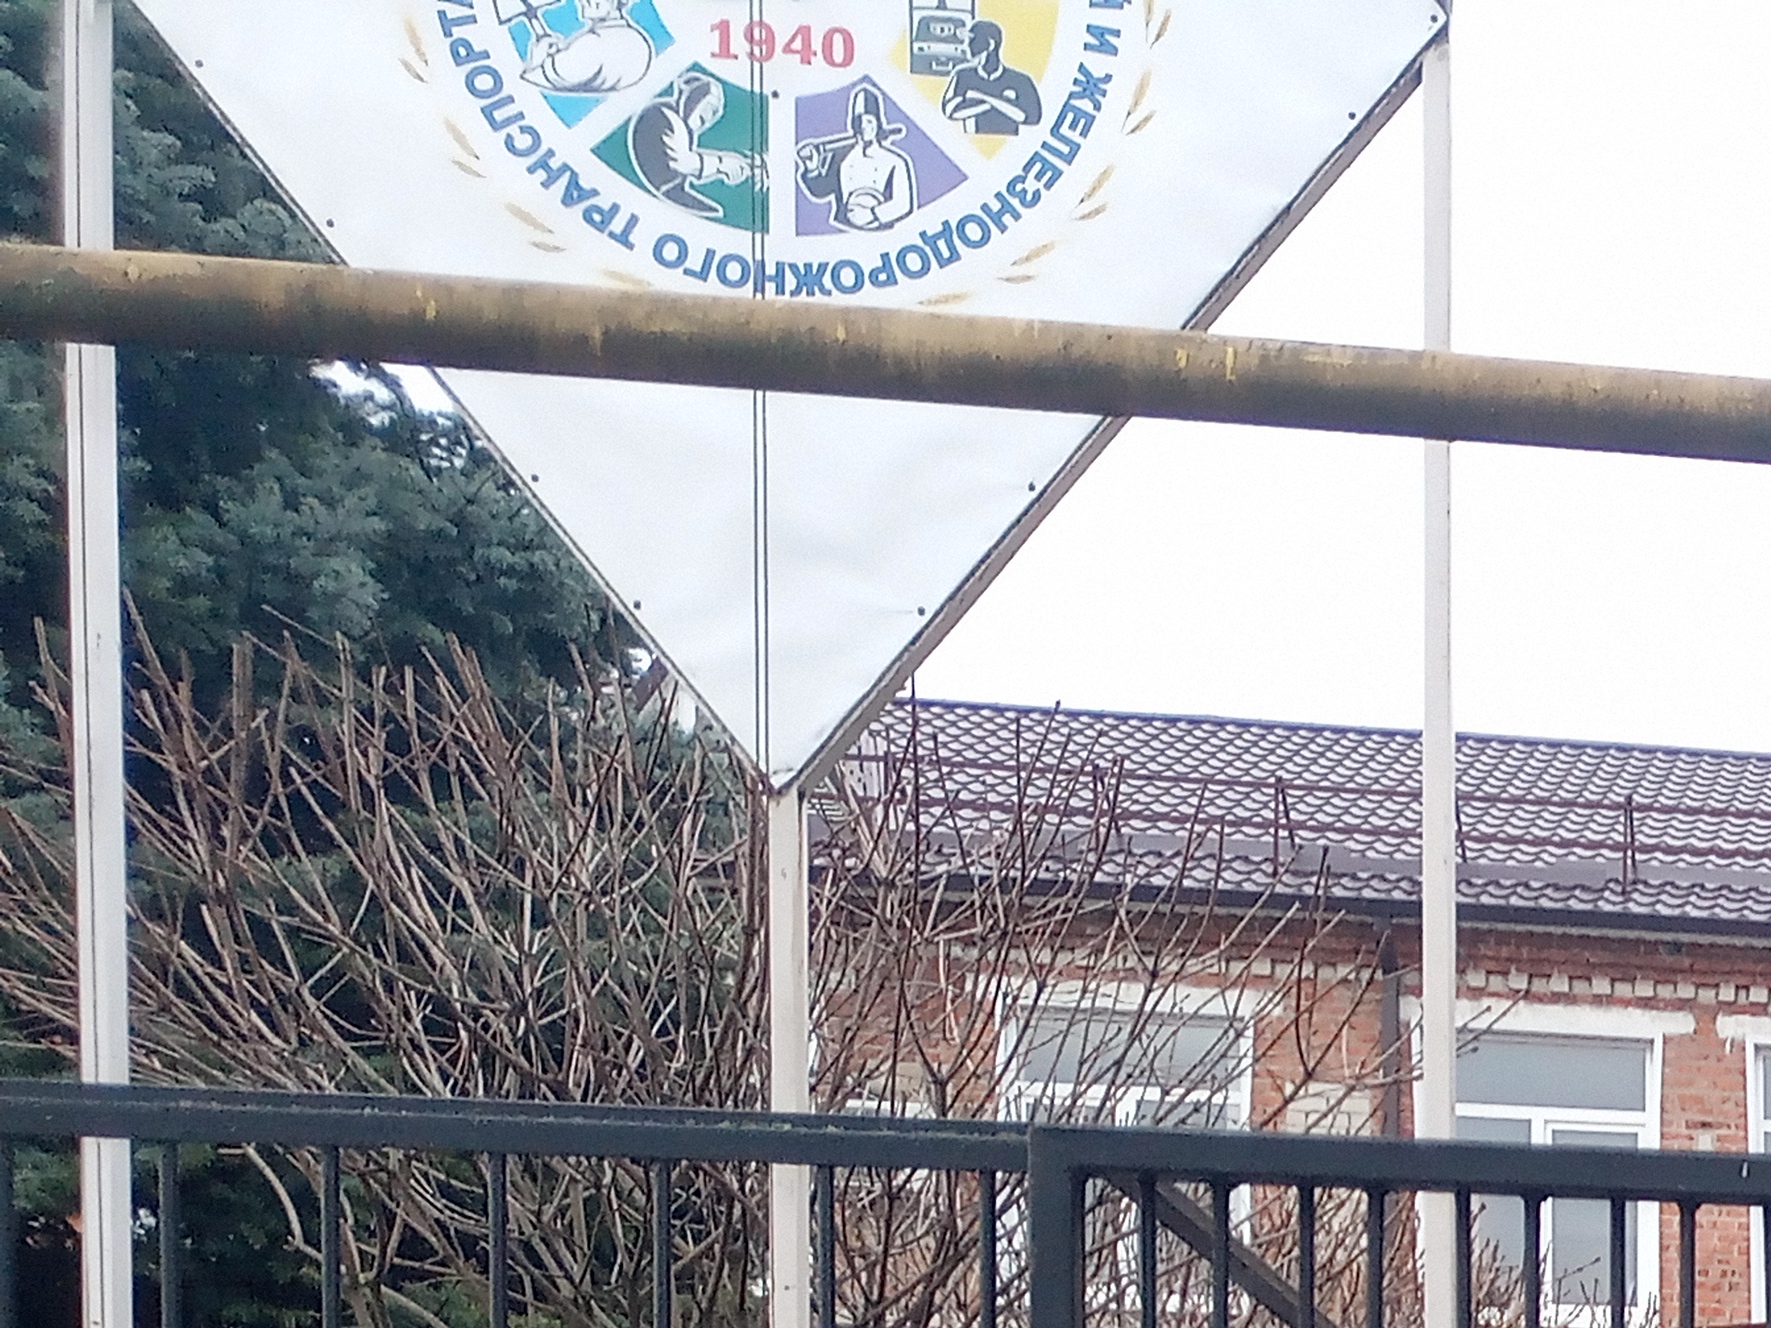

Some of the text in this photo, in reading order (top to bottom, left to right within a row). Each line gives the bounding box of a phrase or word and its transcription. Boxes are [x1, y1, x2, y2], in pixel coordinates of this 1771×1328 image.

[709, 18, 856, 68] 1940
[1084, 23, 1121, 57] И
[652, 62, 1113, 298] ЖЕЛЕЗНОДОРОЖНОГО
